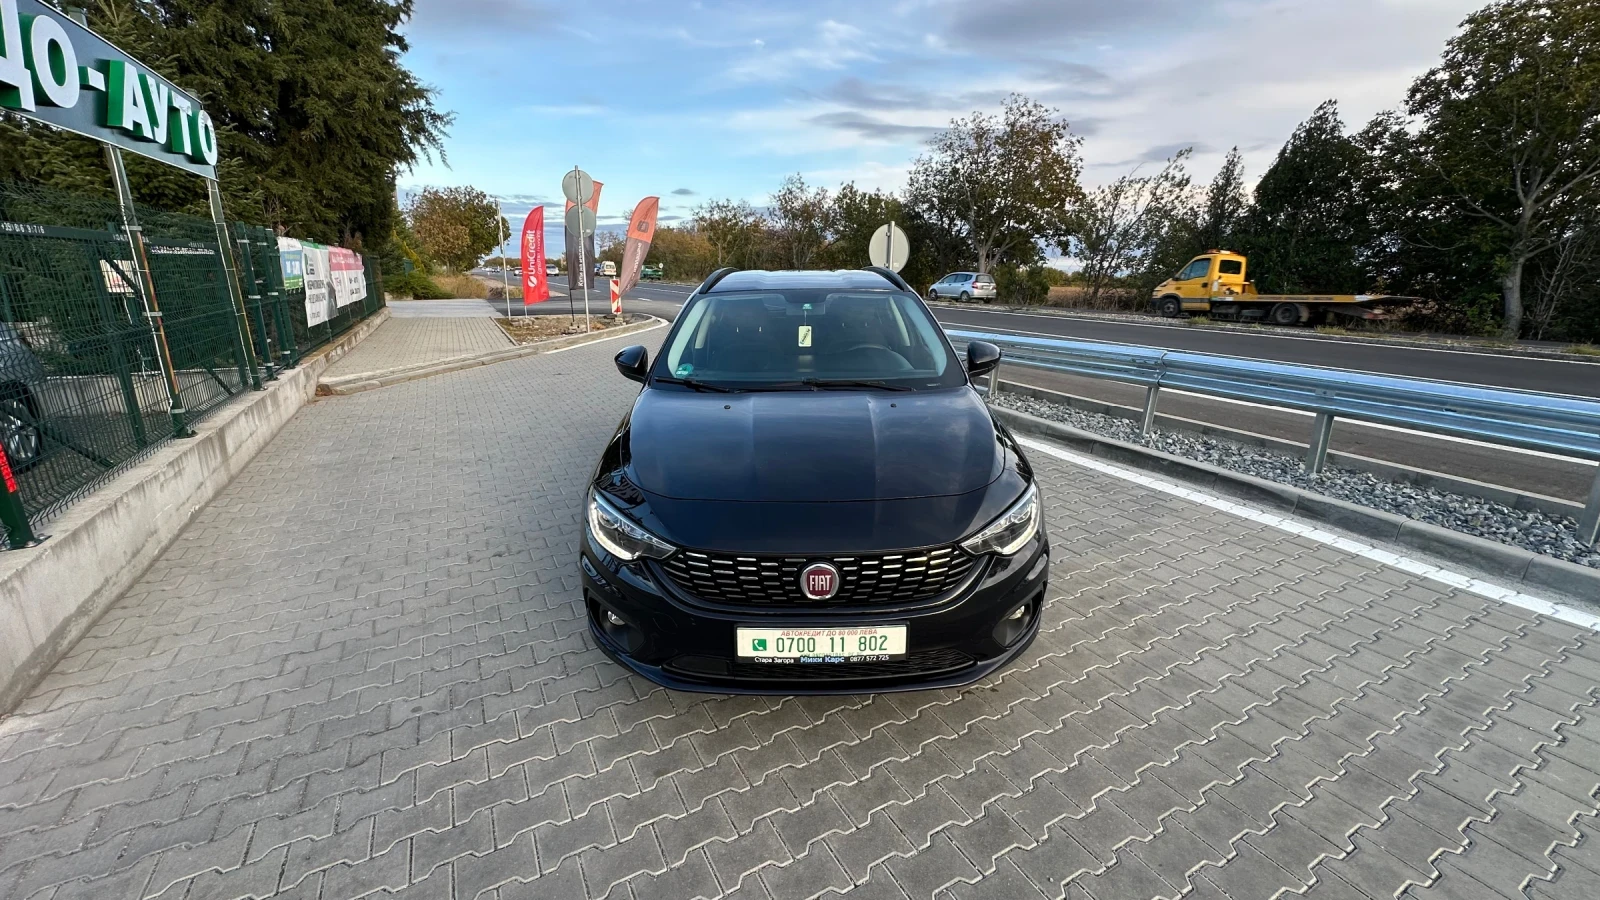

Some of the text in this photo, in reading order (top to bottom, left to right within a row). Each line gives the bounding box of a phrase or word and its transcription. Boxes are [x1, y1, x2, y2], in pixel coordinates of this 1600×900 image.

[526, 229, 536, 275] UniCredit
[809, 574, 832, 591] FIAT
[776, 635, 888, 653] 0700 11 802
[754, 656, 773, 664] Стара
[824, 656, 845, 664] Карс
